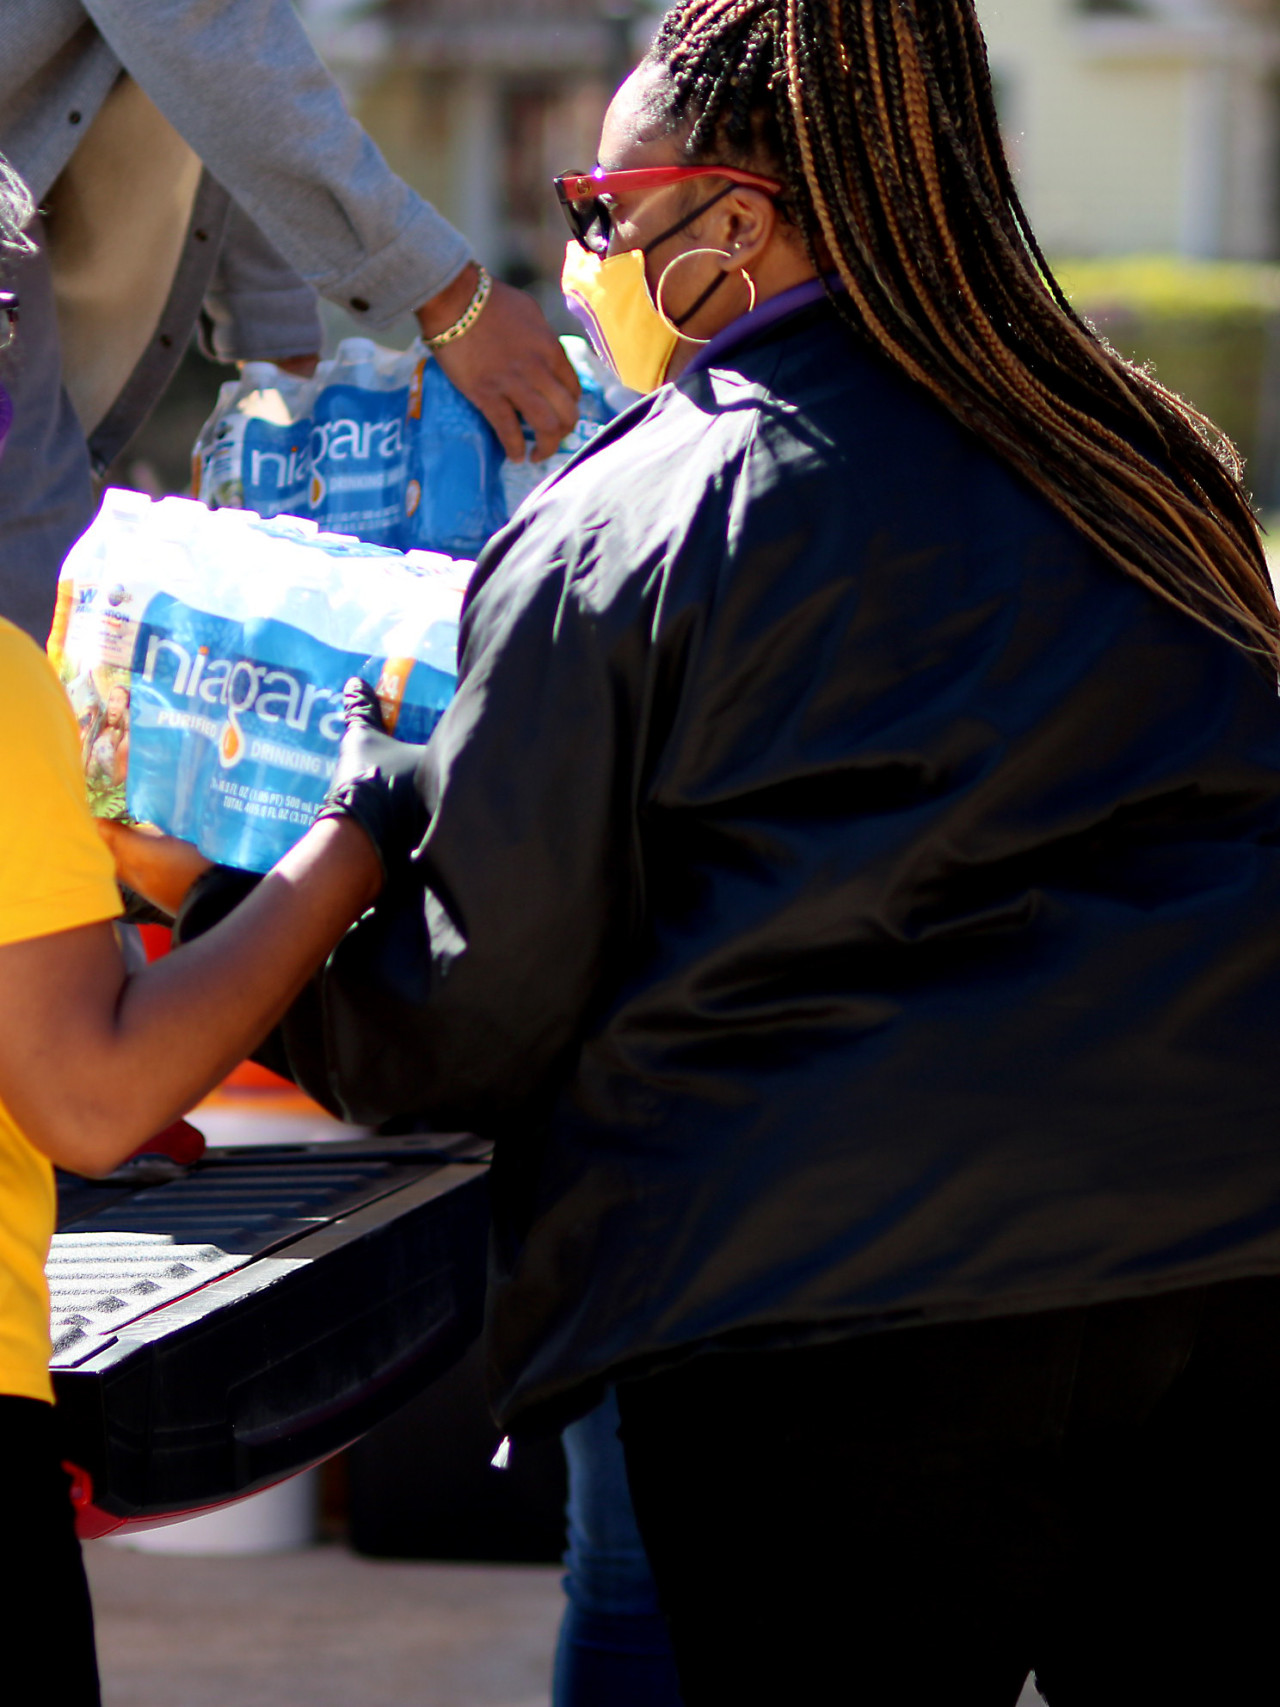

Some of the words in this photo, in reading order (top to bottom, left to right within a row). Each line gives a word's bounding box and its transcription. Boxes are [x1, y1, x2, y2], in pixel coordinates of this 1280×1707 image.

[251, 418, 403, 489] niagara
[142, 634, 347, 750] niagara
[157, 711, 217, 737] PURIFIED
[251, 741, 320, 773] DRINKING
[223, 795, 243, 812] TOTAL
